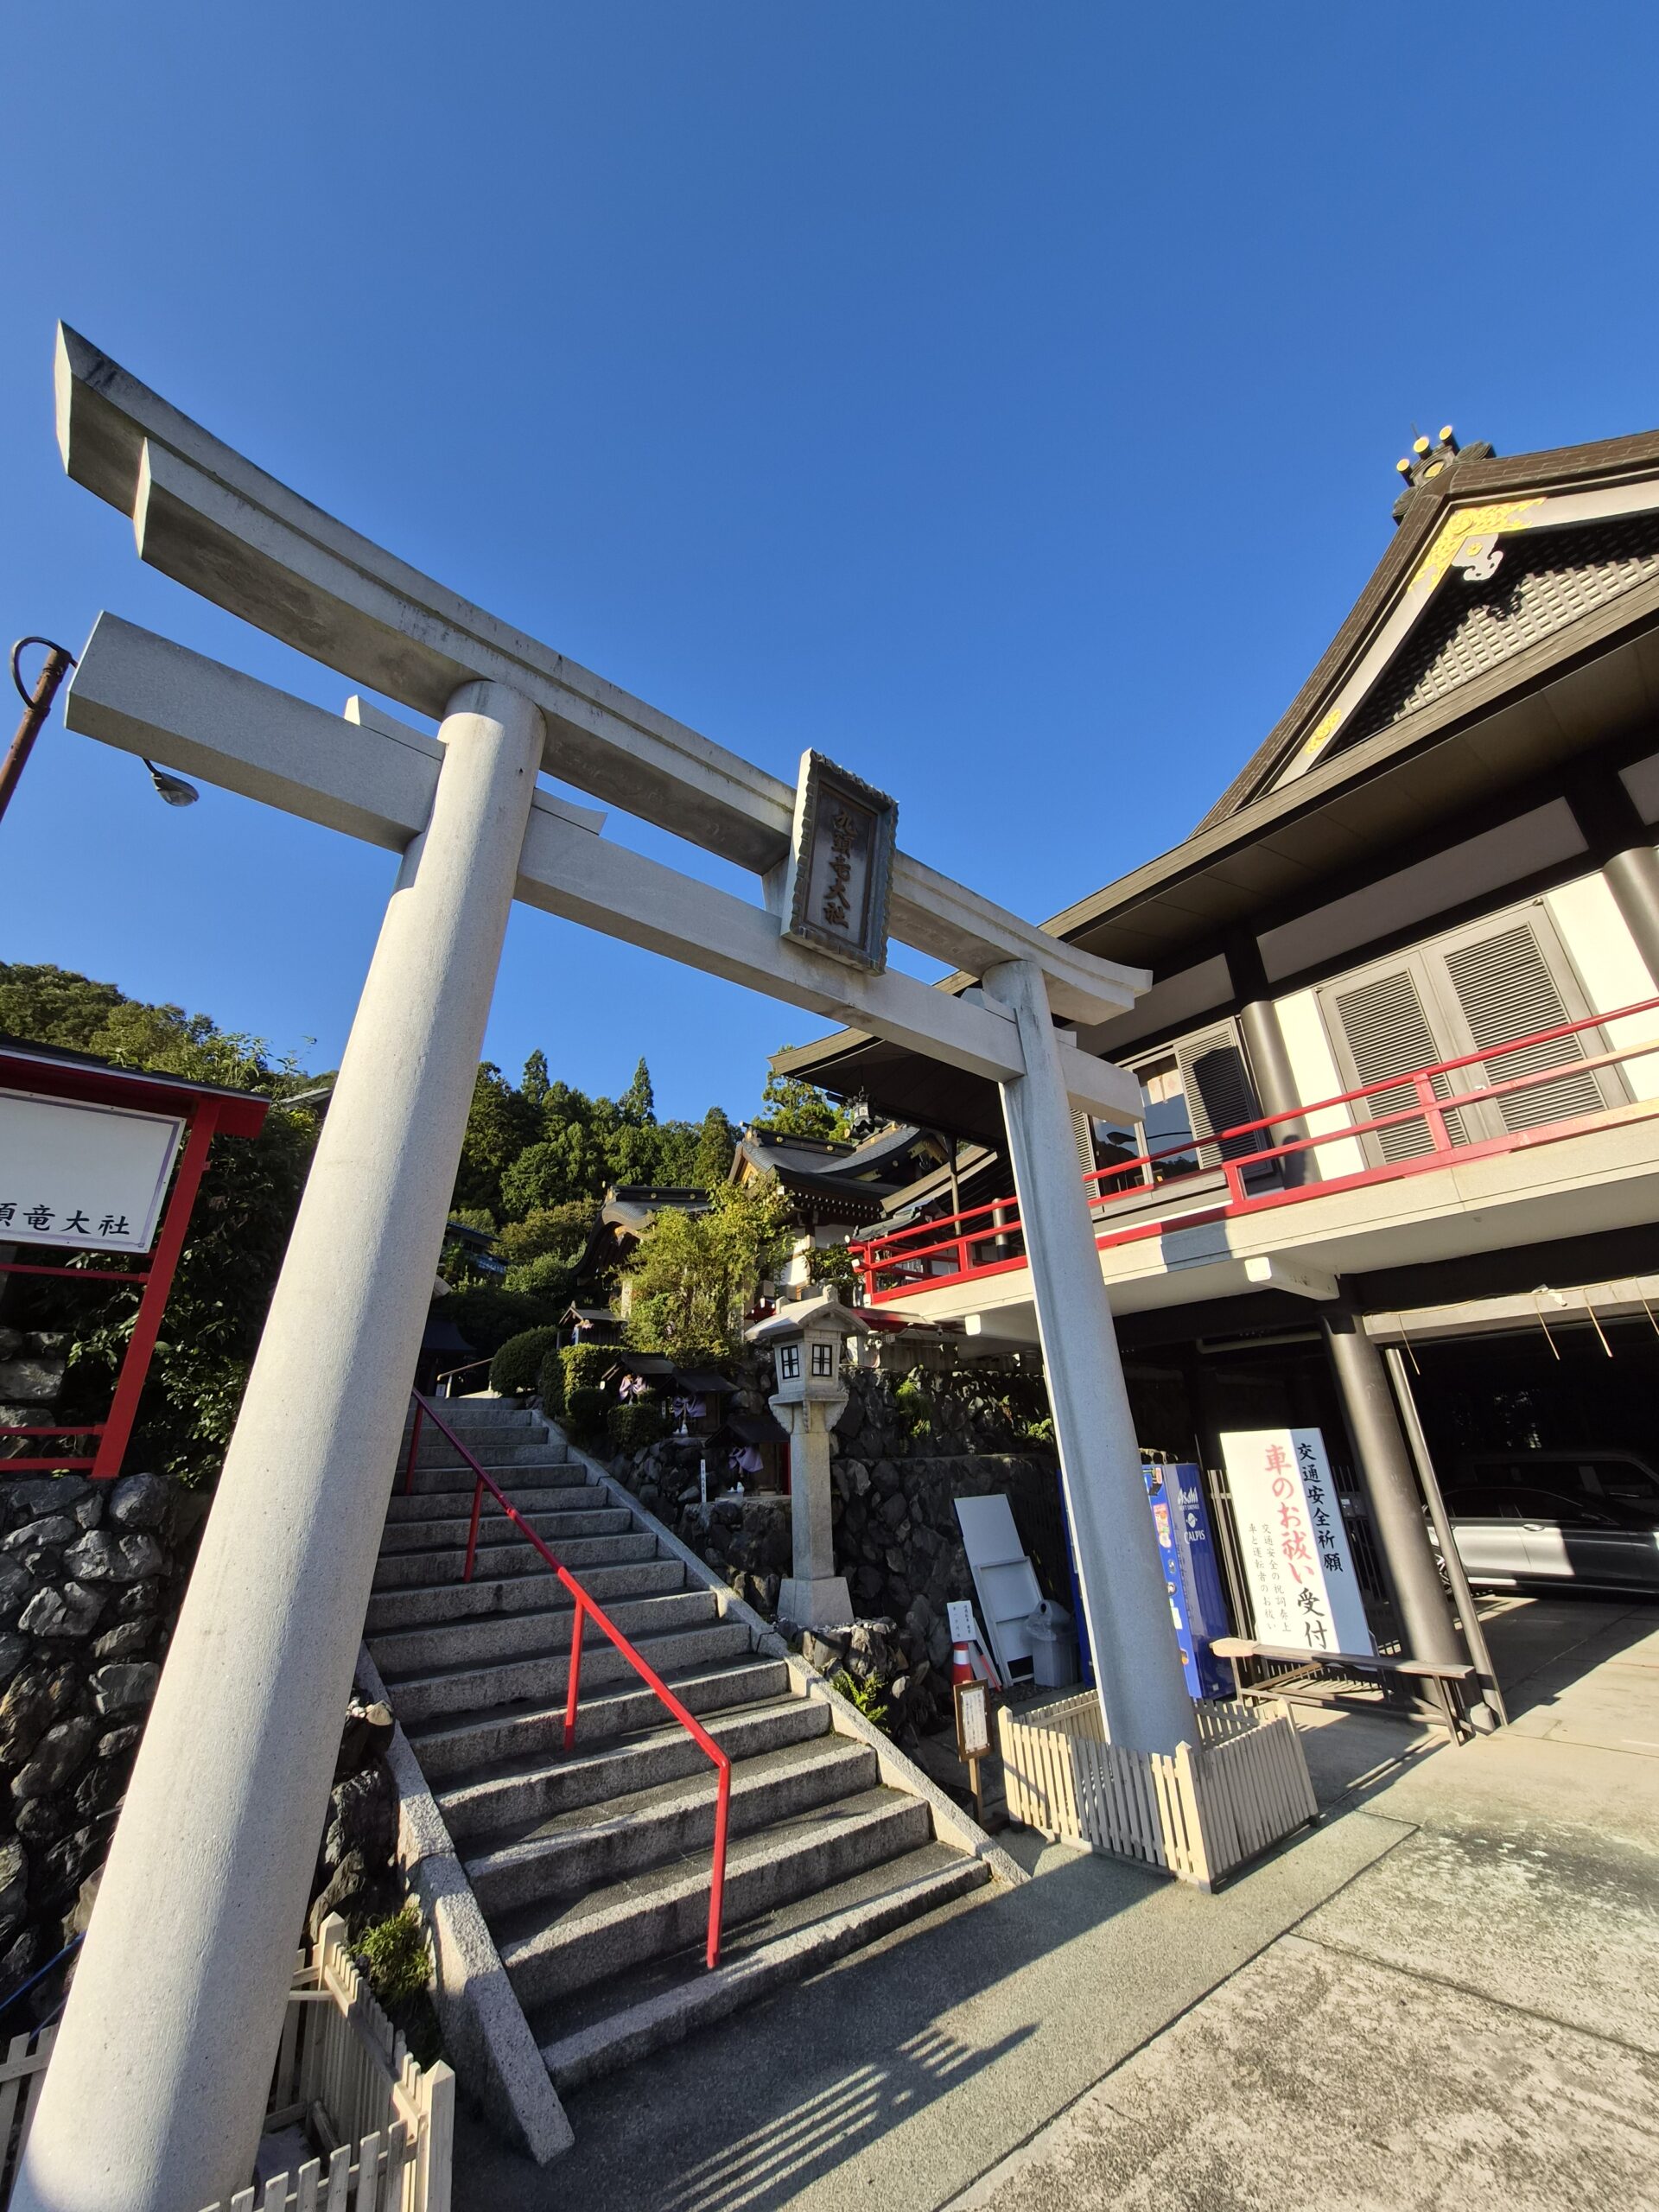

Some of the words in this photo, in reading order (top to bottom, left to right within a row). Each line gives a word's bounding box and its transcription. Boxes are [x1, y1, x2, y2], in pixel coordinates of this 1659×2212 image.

[1184, 1529, 1205, 1545] CALPIS
[1297, 1442, 1344, 1573] 交通安全祈願
